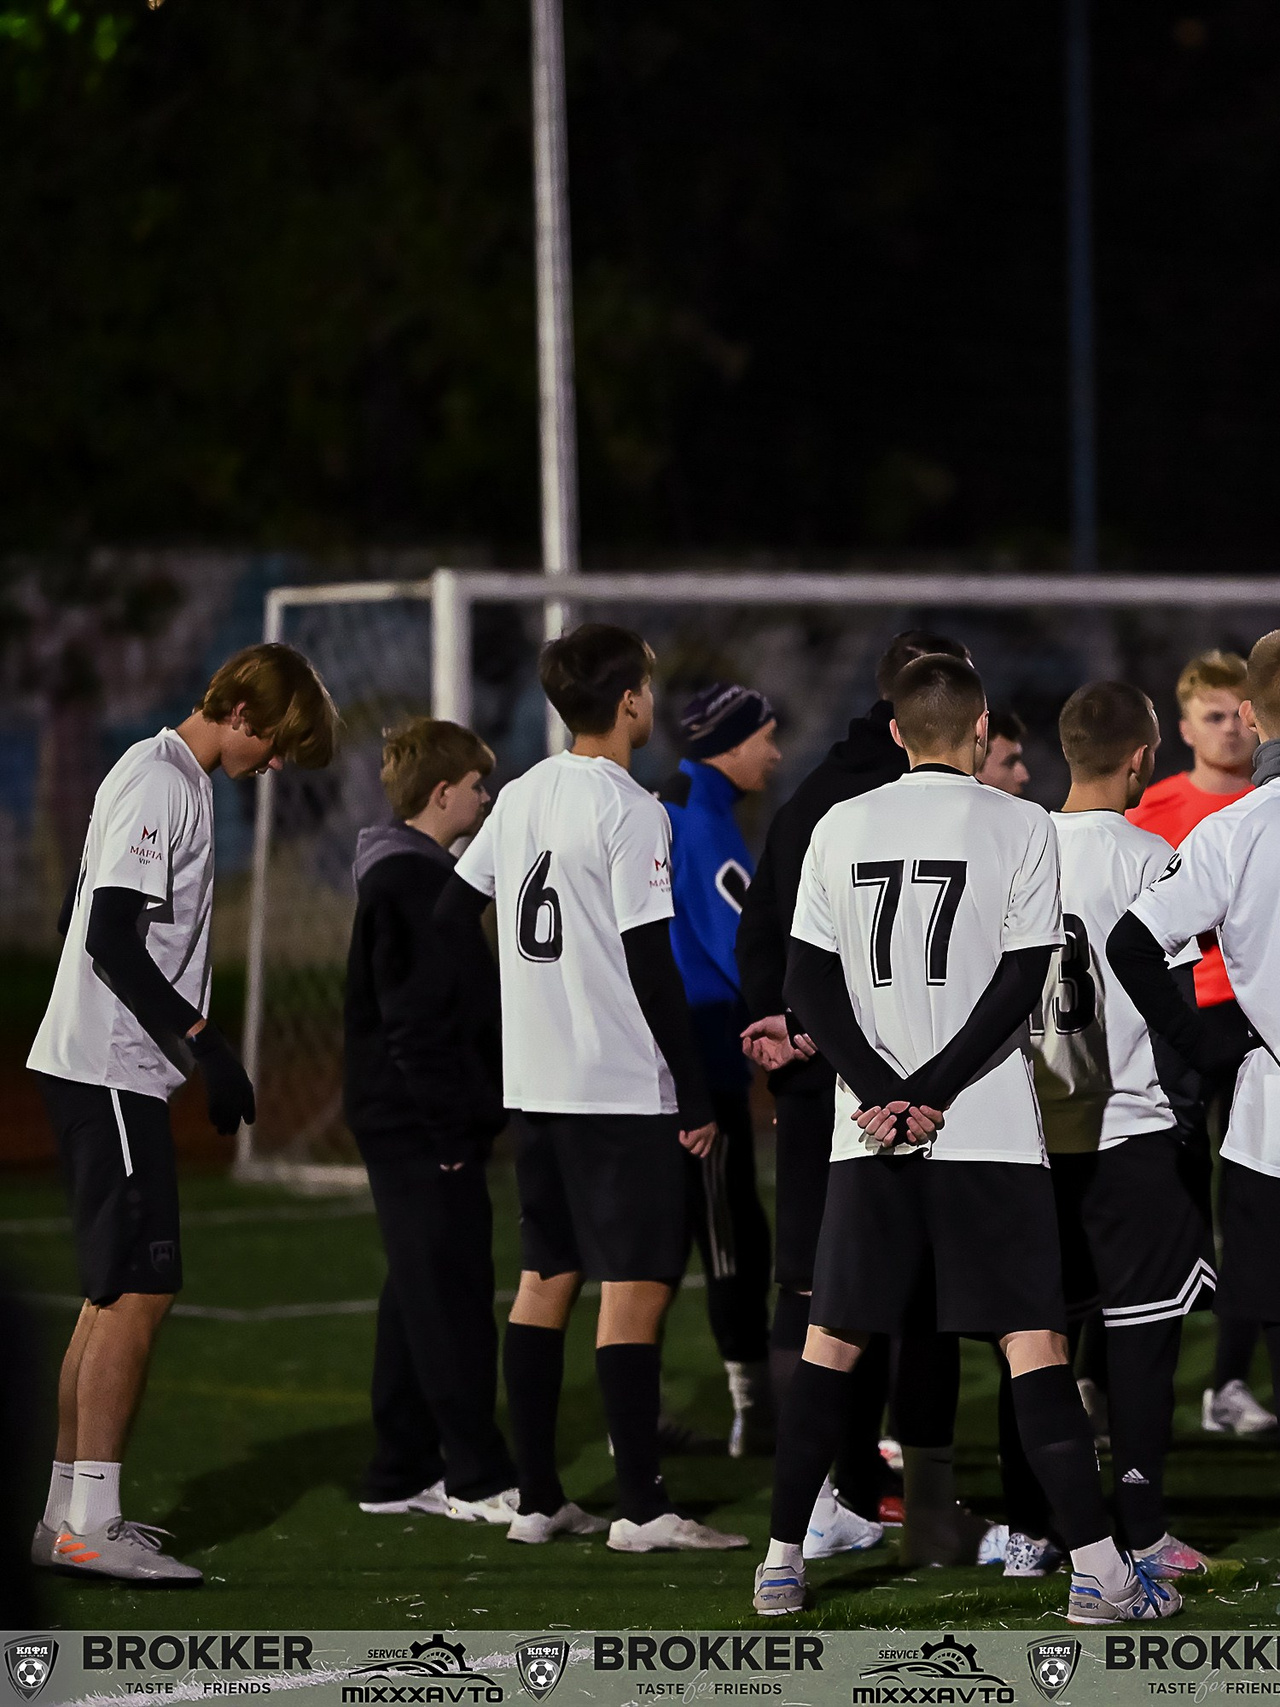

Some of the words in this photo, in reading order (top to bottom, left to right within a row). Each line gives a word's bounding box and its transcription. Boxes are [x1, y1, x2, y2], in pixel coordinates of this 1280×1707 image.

[130, 845, 162, 861] MAFIA
[515, 850, 564, 963] 6
[851, 859, 968, 988] 77
